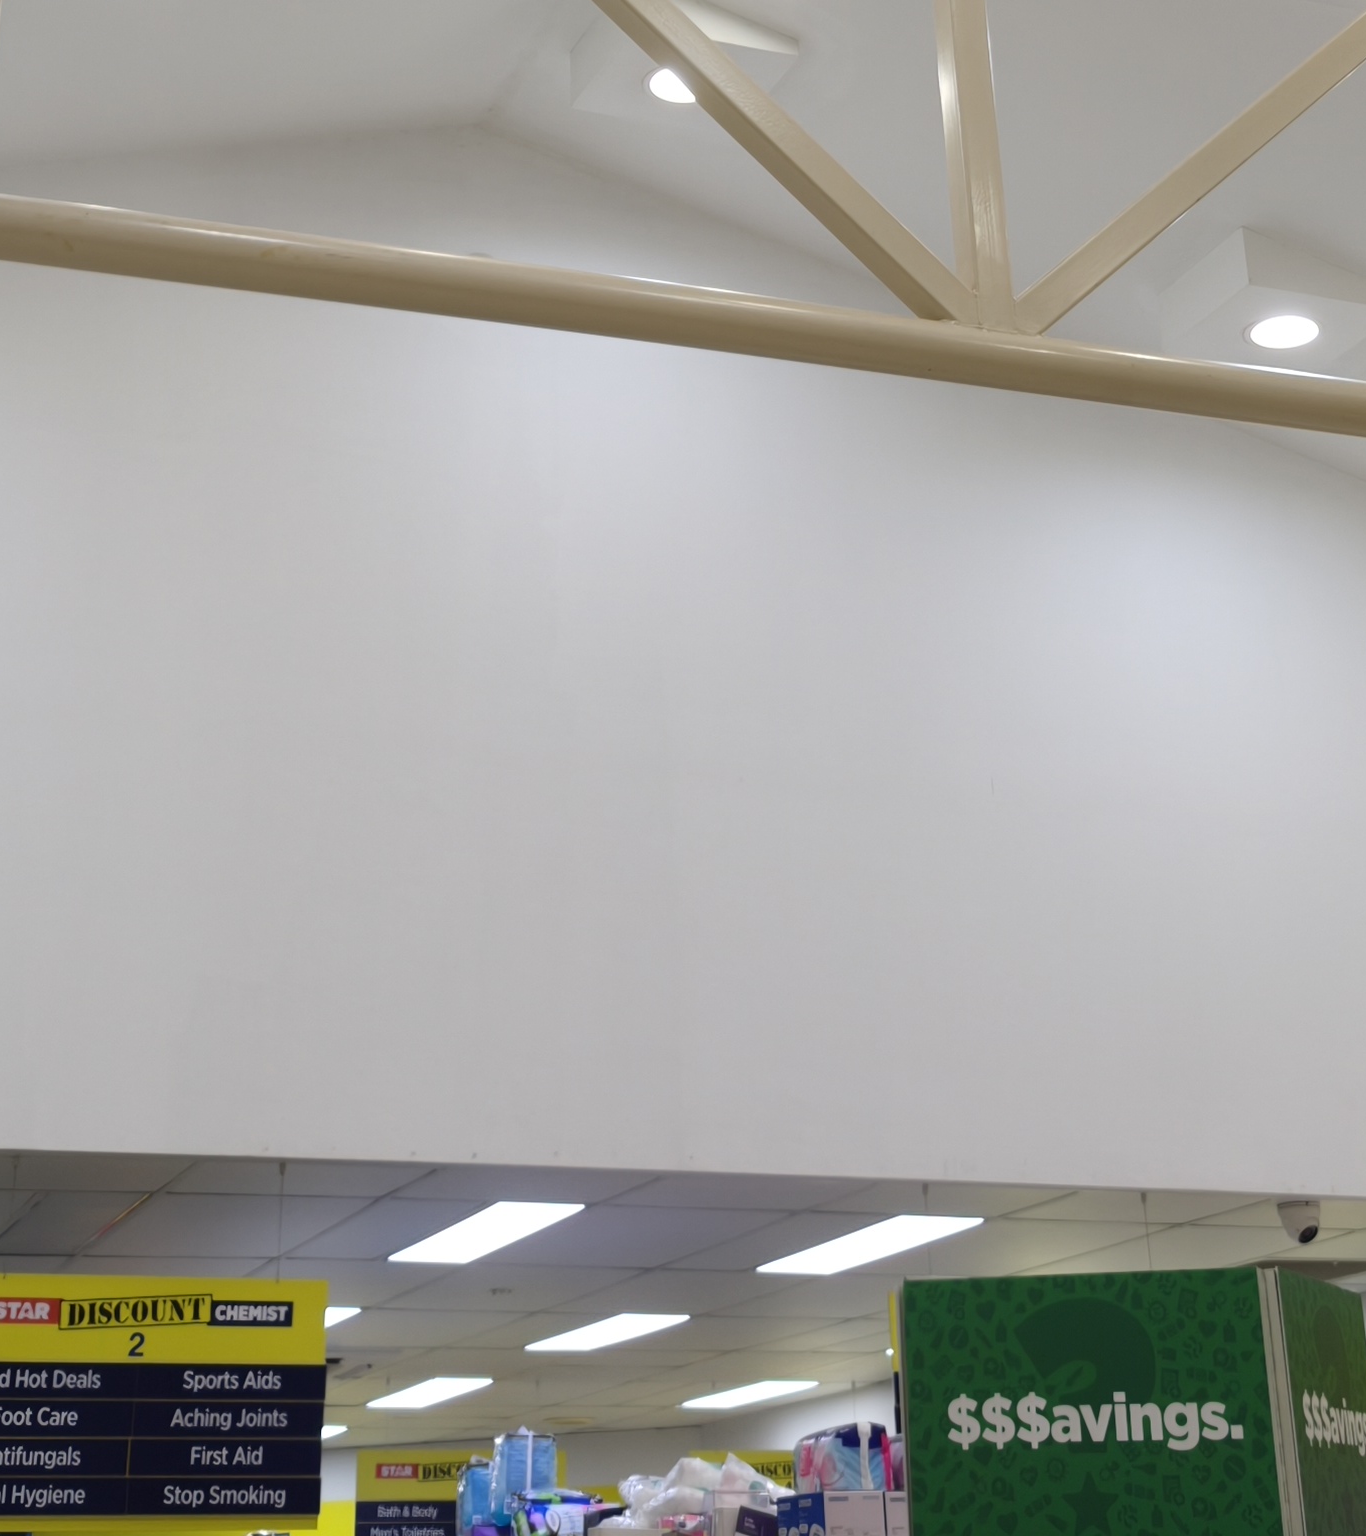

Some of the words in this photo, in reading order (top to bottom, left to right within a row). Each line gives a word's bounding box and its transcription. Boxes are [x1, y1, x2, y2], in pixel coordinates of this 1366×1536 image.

[67, 1298, 206, 1327] DISCOUNT
[215, 1305, 290, 1322] CHEMIST
[128, 1332, 145, 1357] 2
[15, 1369, 48, 1389] Hot
[52, 1369, 101, 1390] Deals
[183, 1370, 239, 1392] Sports
[243, 1370, 282, 1390] Aids
[37, 1407, 78, 1427] Care
[170, 1408, 232, 1432] Aching
[235, 1408, 288, 1429] Joints
[947, 1391, 1244, 1451] $$$avings.
[190, 1446, 229, 1466] First
[233, 1446, 263, 1466] Aid
[381, 1466, 413, 1477] STAR
[13, 1484, 86, 1508] Hygiene
[163, 1485, 205, 1509] Stop
[209, 1485, 286, 1509] Smoking
